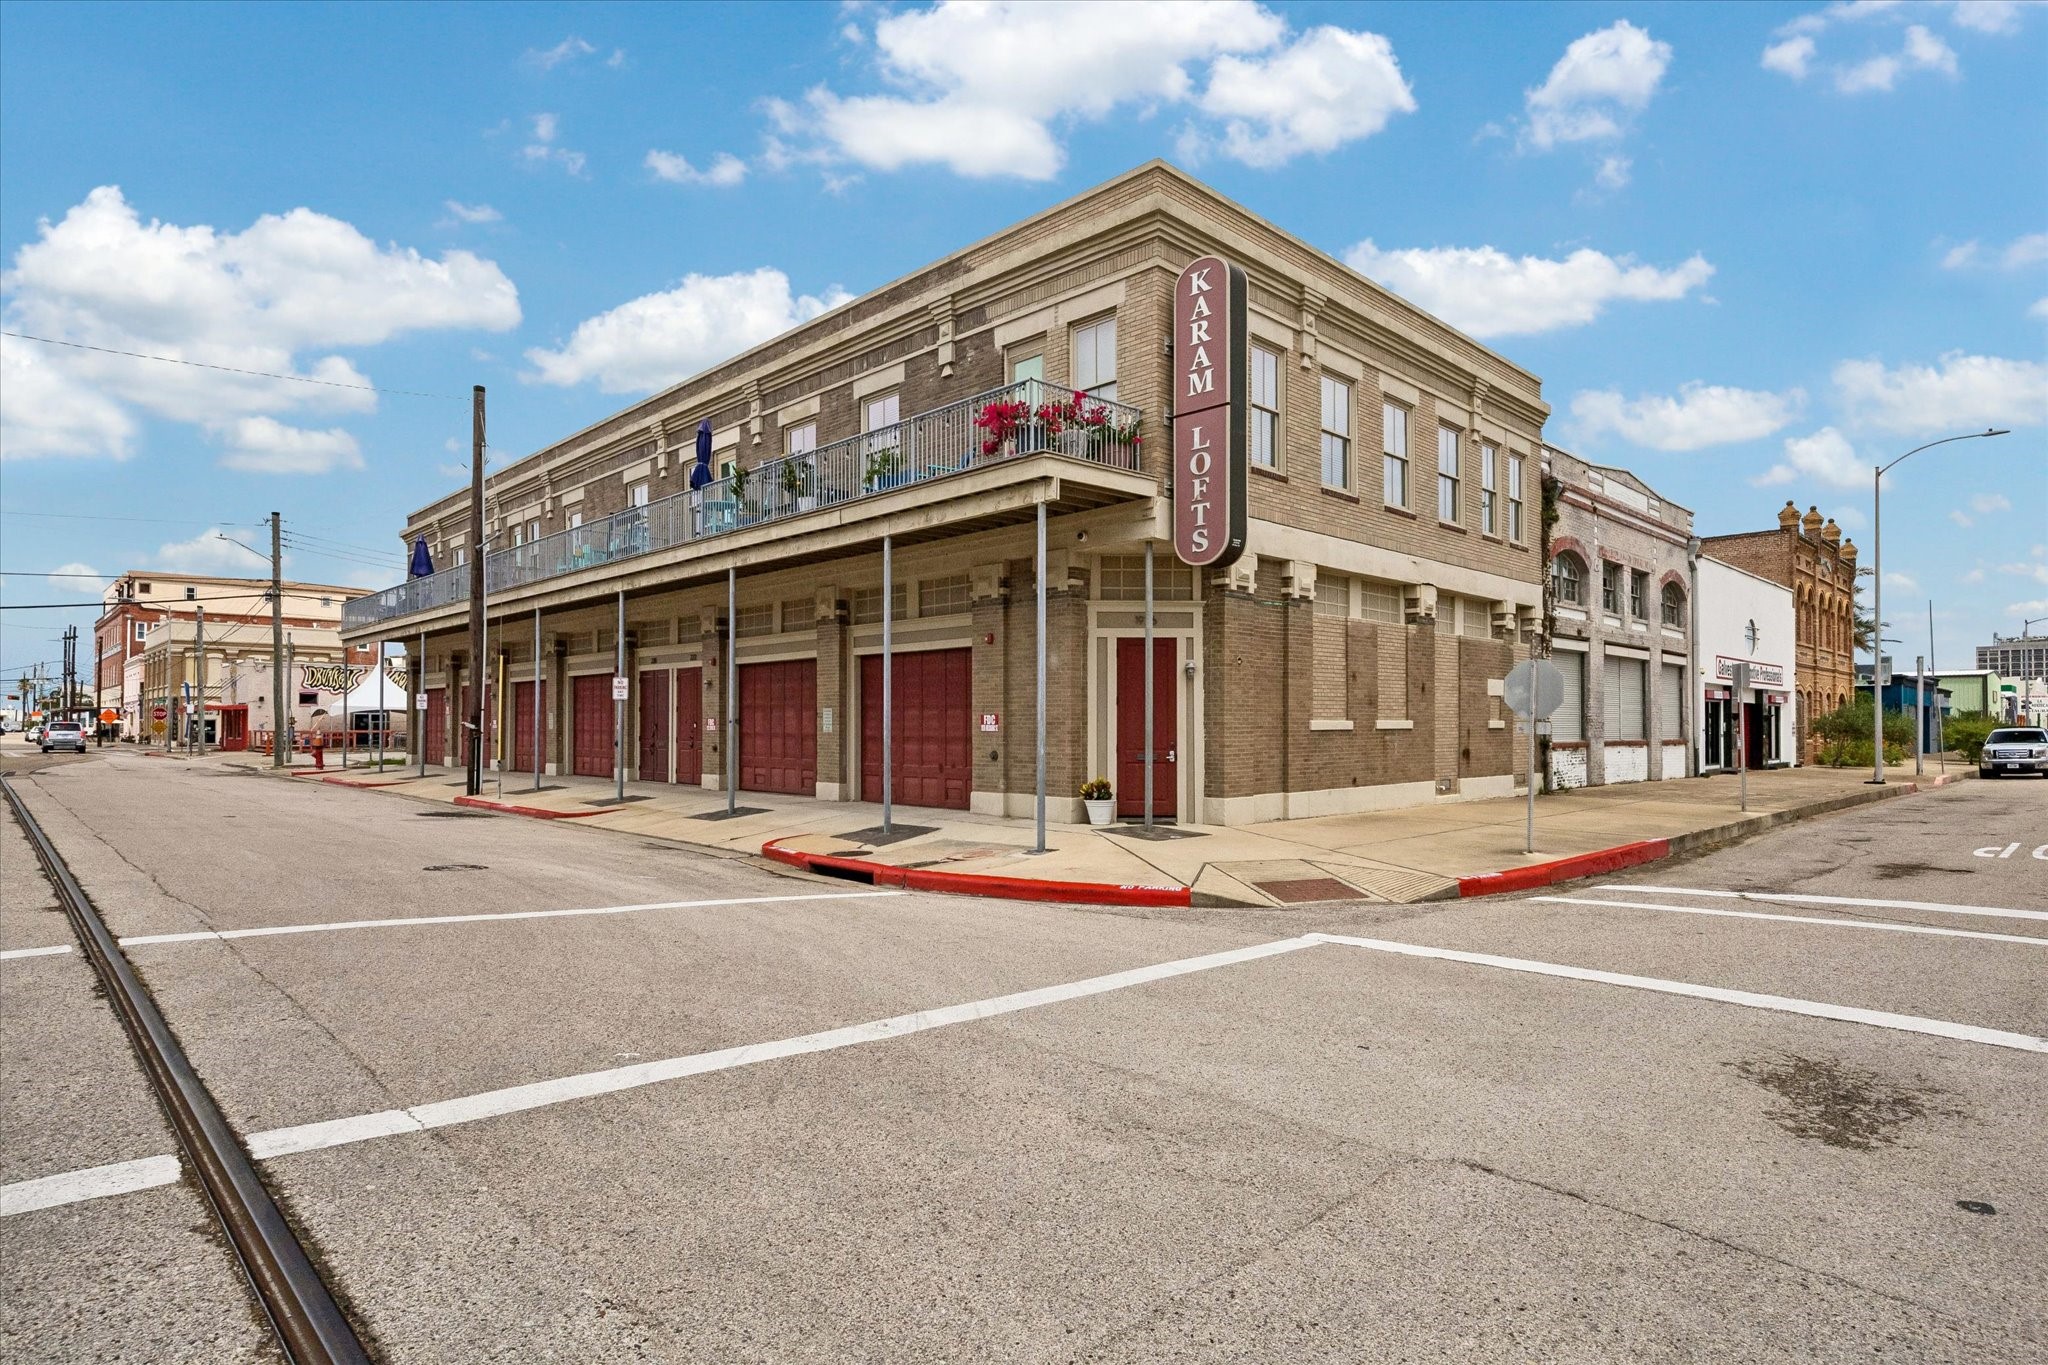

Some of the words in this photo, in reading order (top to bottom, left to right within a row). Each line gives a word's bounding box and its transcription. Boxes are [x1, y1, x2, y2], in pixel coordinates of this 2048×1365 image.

[1187, 267, 1214, 396] KARAM
[1190, 426, 1211, 552] LOFTS
[983, 714, 996, 725] FDC
